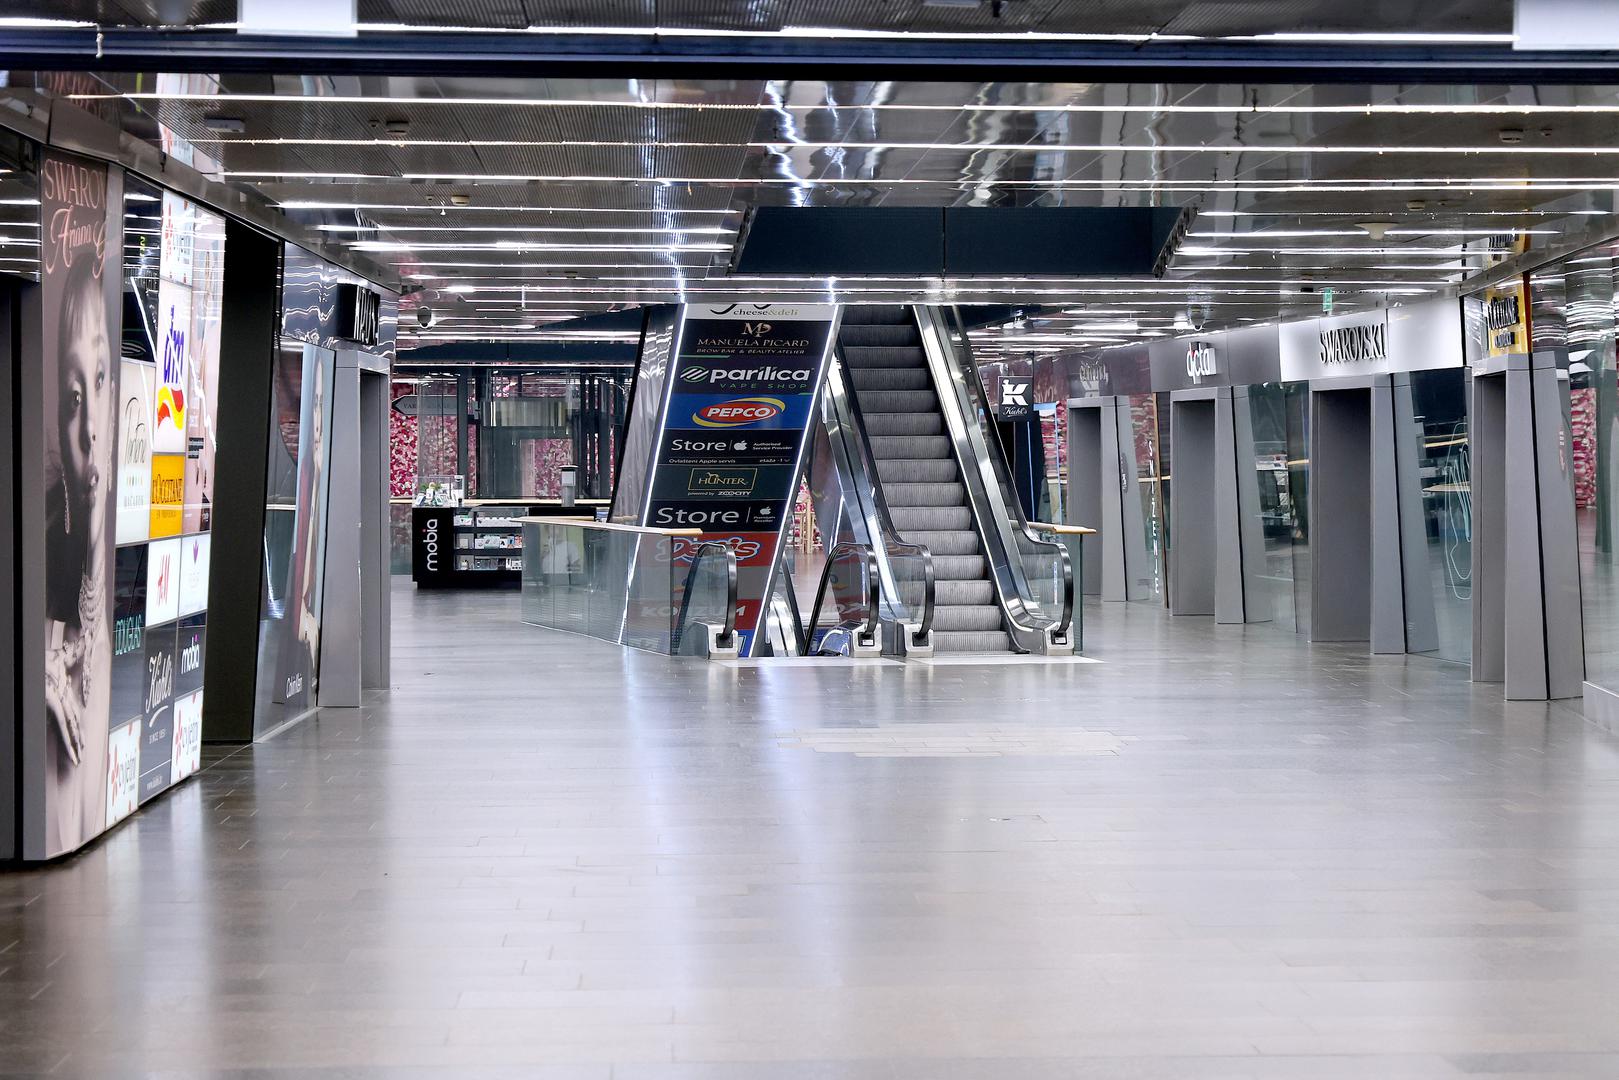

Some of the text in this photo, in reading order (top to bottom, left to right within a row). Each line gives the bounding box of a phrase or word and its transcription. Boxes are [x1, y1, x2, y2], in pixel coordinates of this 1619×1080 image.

[163, 305, 184, 384] dm
[697, 338, 810, 348] MANUELA PICARD
[1320, 323, 1386, 364] SWAROVSKI
[709, 365, 811, 383] parilica
[707, 407, 771, 418] PEPCO
[671, 439, 728, 451] Store
[698, 476, 748, 486] HUNTER
[655, 507, 740, 524] Store
[423, 518, 438, 572] mobia
[181, 633, 200, 674] mobia
